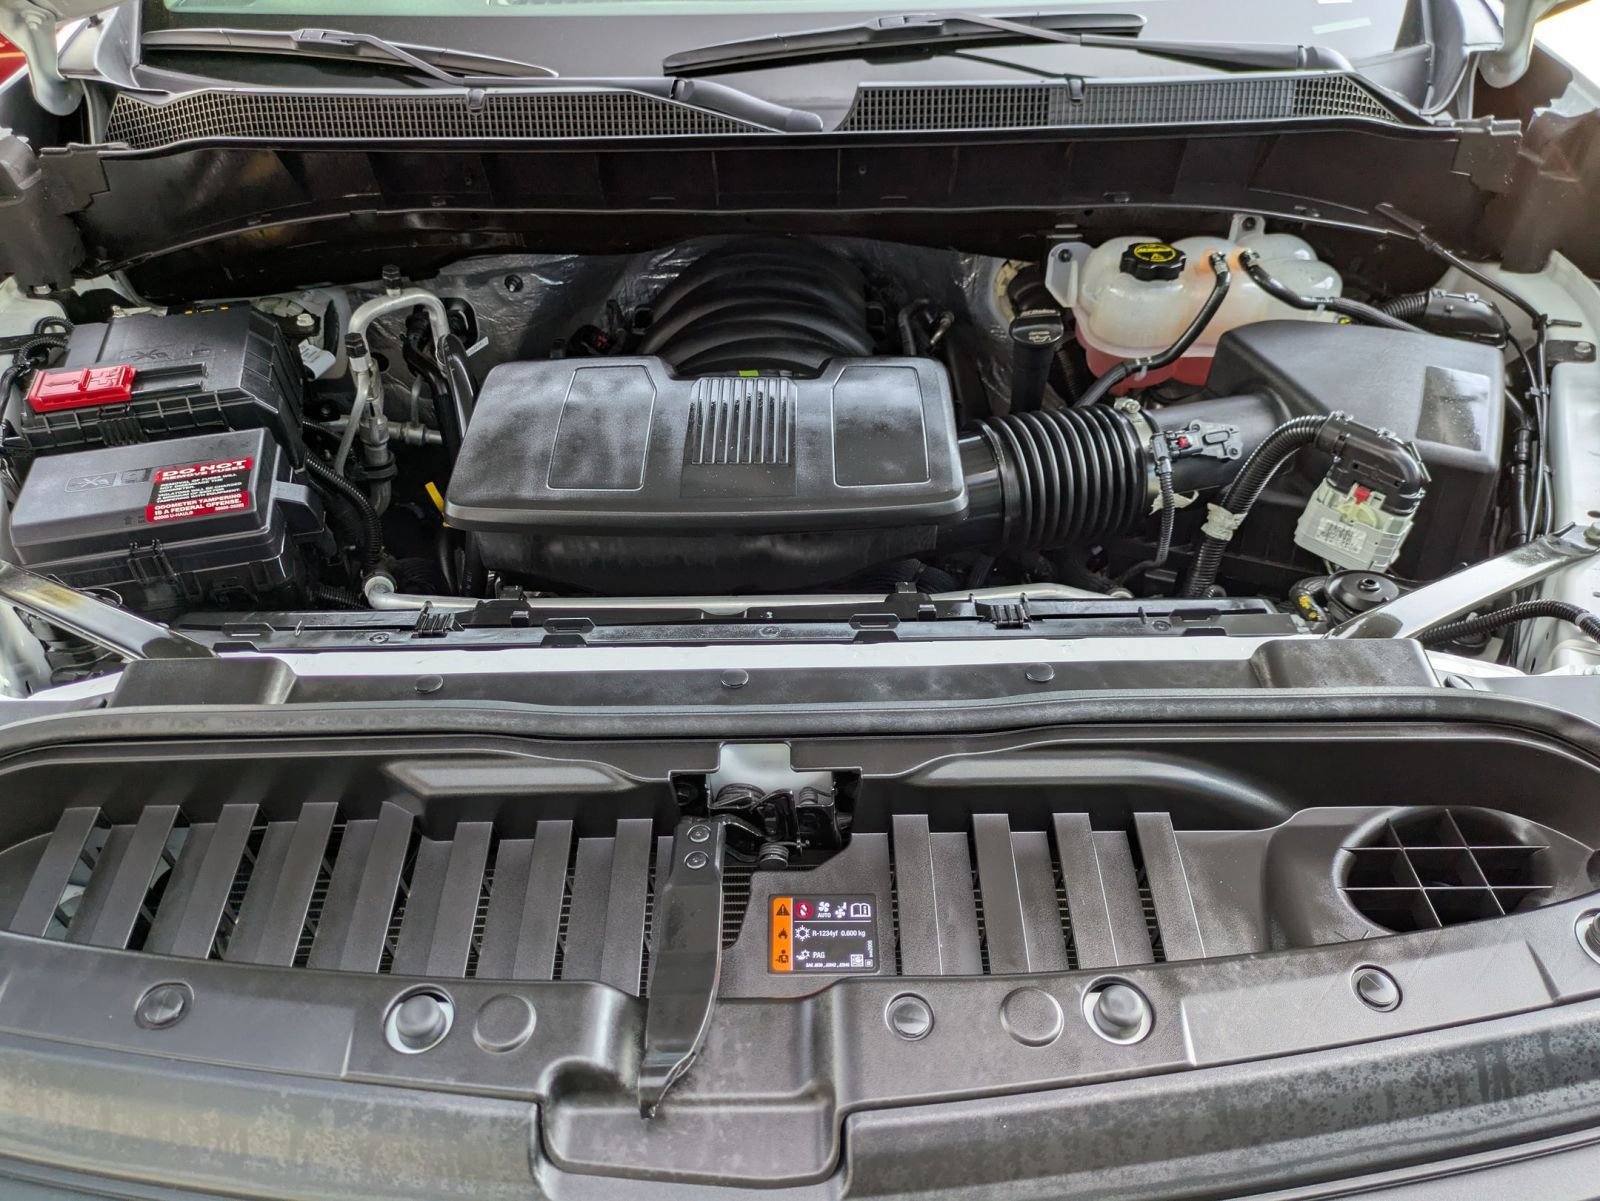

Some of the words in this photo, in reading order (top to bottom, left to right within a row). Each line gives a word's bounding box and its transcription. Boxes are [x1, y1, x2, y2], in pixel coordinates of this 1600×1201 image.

[162, 471, 207, 480] REMOVE
[163, 468, 196, 477] DO
[200, 460, 246, 471] NOT
[155, 500, 197, 510] ODOMETER
[199, 494, 242, 503] TAMPERING
[171, 504, 205, 513] FEDERAL
[206, 499, 242, 508] OFFENSE.
[812, 930, 838, 938] R-1234yf
[858, 930, 866, 938] kg
